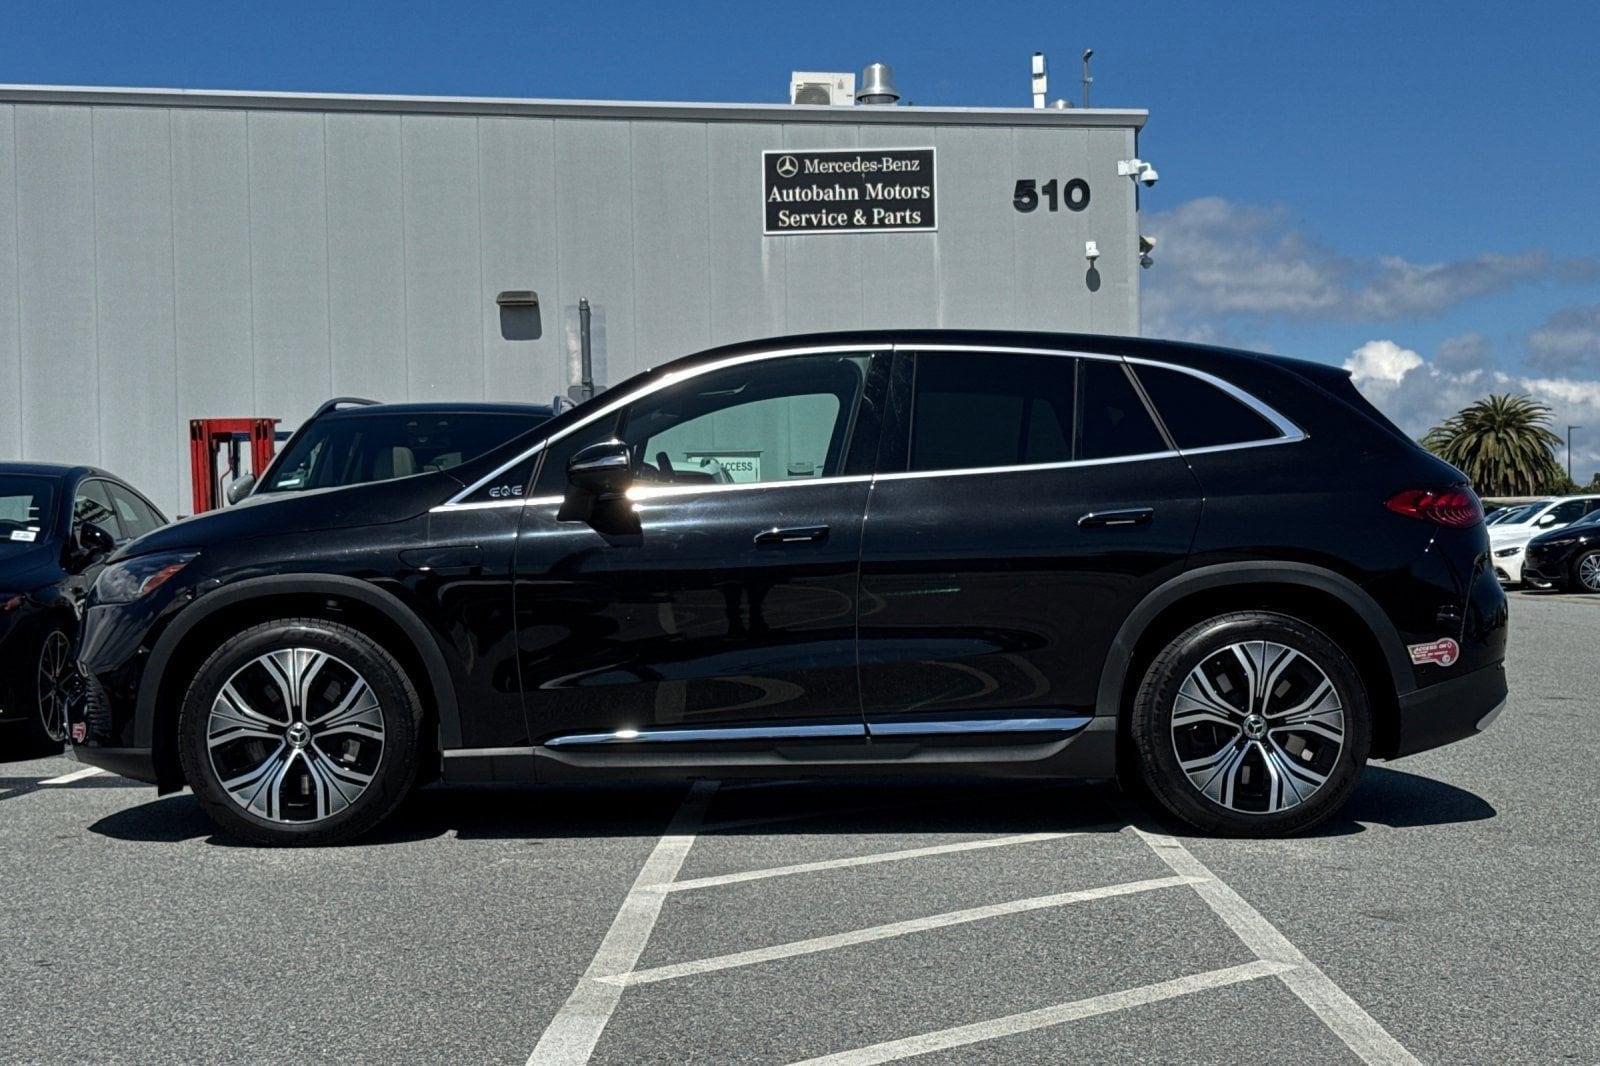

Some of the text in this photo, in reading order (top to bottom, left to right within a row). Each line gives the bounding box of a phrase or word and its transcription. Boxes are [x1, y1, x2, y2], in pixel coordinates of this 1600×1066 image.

[804, 157, 920, 174] Mercedes-Benz
[768, 183, 931, 203] Autobahn Motors
[1013, 178, 1091, 213] 510
[778, 208, 921, 227] Service & Parts
[488, 484, 523, 498] EQE
